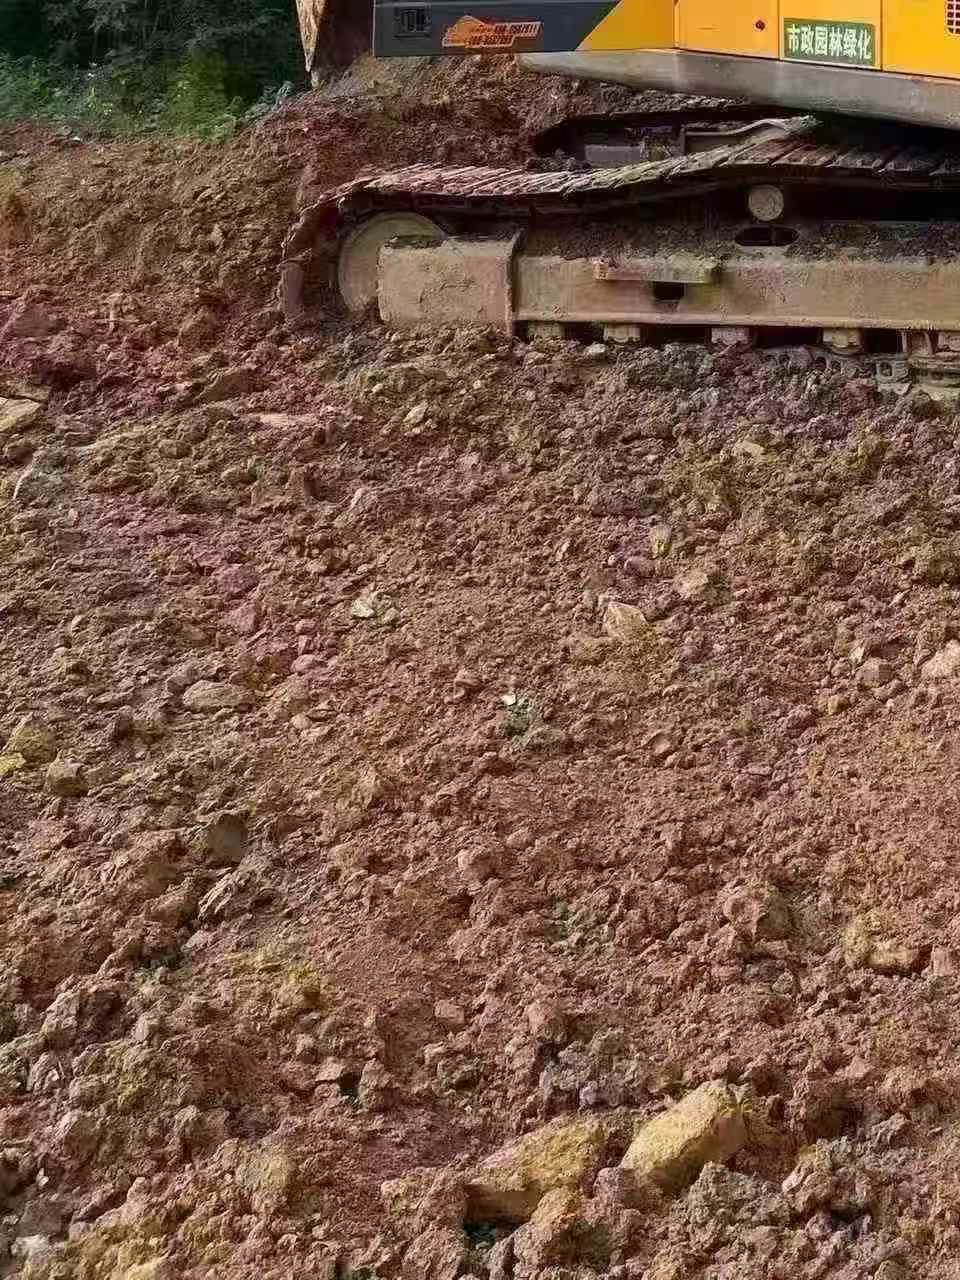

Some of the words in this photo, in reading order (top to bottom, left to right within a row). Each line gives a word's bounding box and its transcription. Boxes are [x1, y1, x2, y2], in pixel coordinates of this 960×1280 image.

[786, 24, 872, 60] 市政园林绿化
